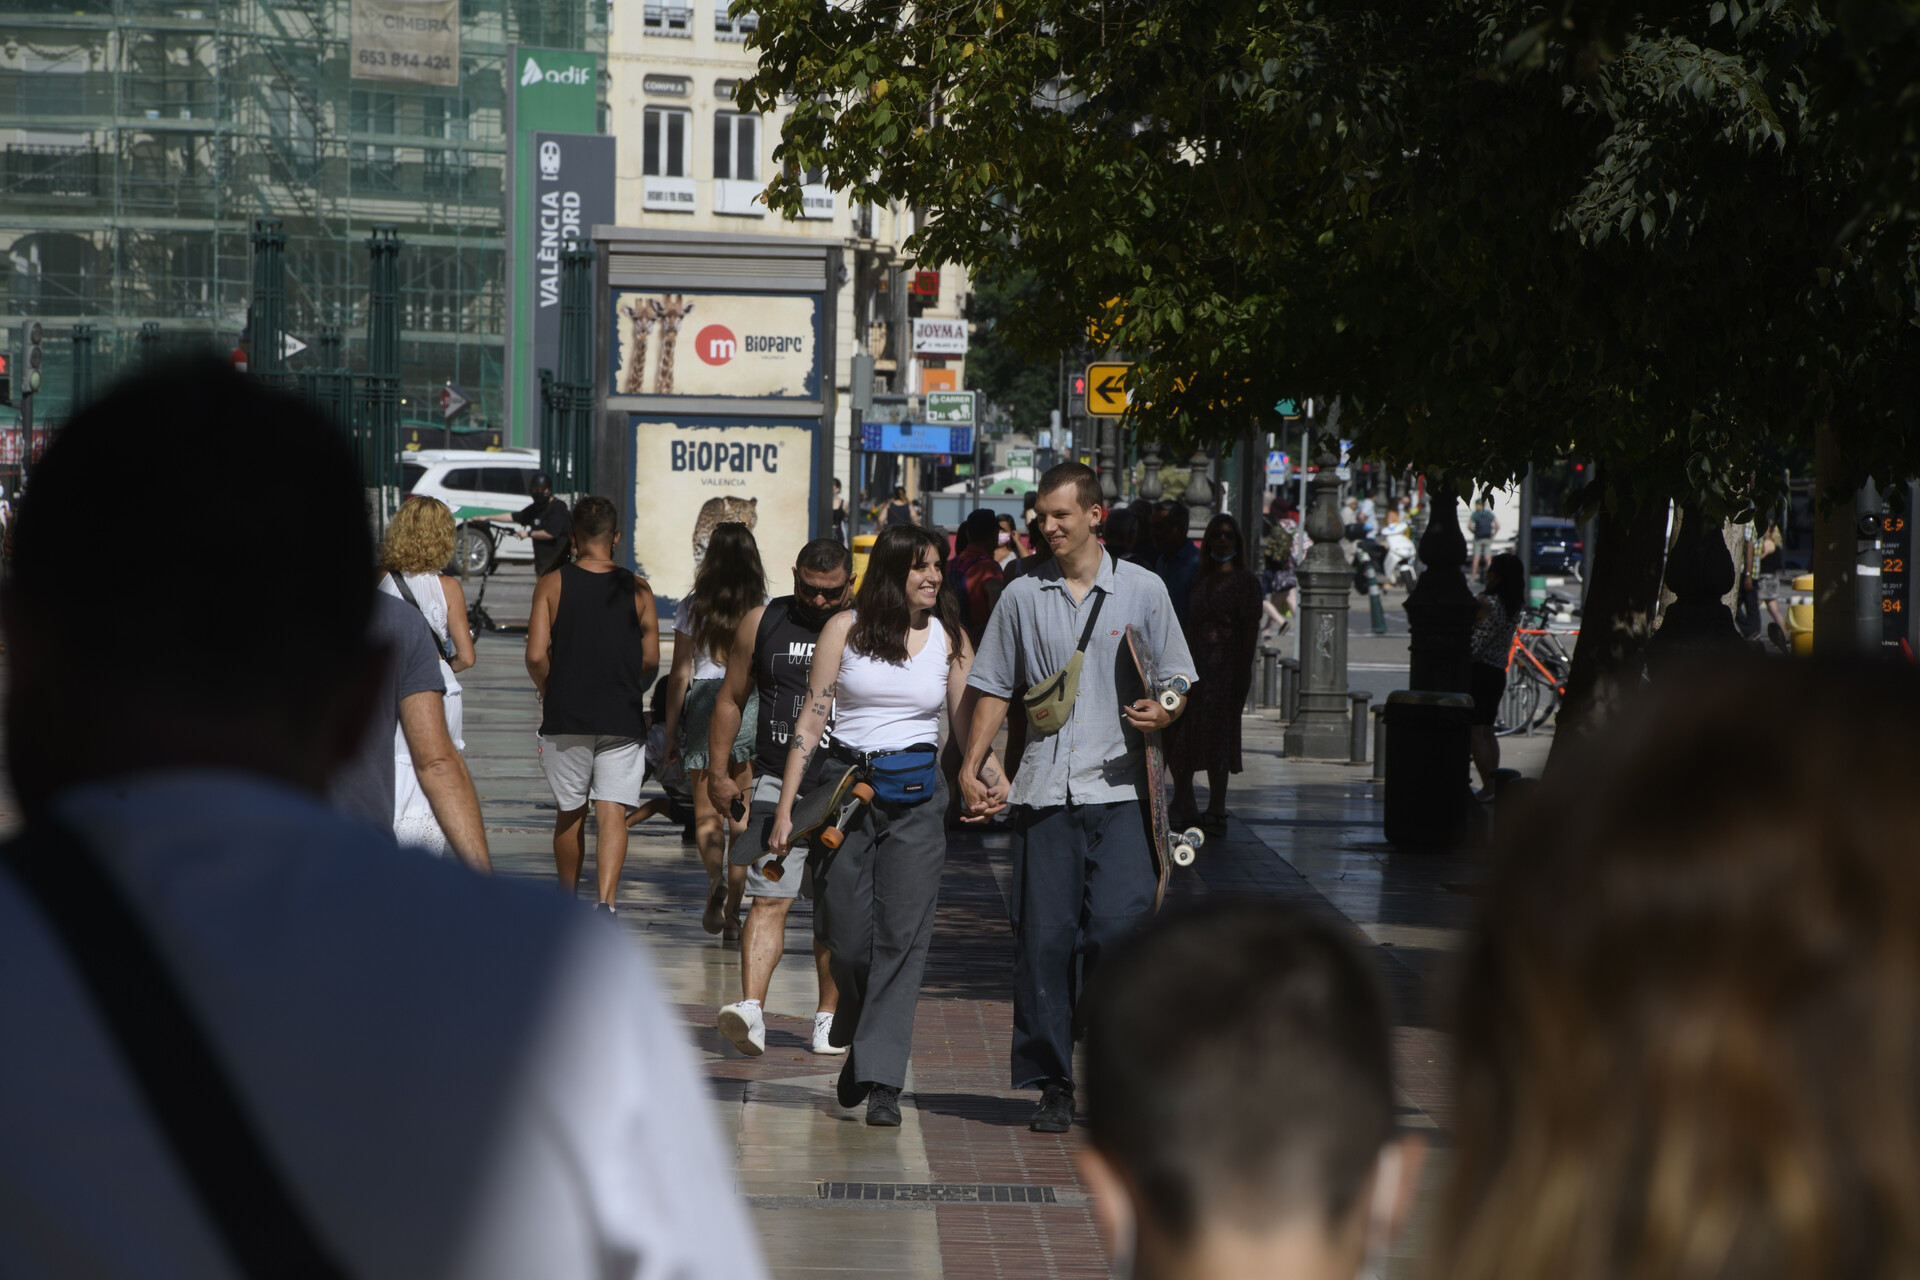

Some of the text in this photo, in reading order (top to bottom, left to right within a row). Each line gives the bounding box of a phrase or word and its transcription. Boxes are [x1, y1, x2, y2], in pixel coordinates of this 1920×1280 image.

[383, 14, 451, 32] CIMBRA
[360, 50, 451, 70] 653 814 424
[545, 66, 591, 86] adif
[562, 191, 581, 253] ORD
[537, 190, 560, 308] VALÈNCIA
[916, 324, 964, 339] JOYMA
[940, 396, 971, 404] CARRER
[671, 440, 778, 473] Bioparc
[700, 478, 746, 486] VALENCIA
